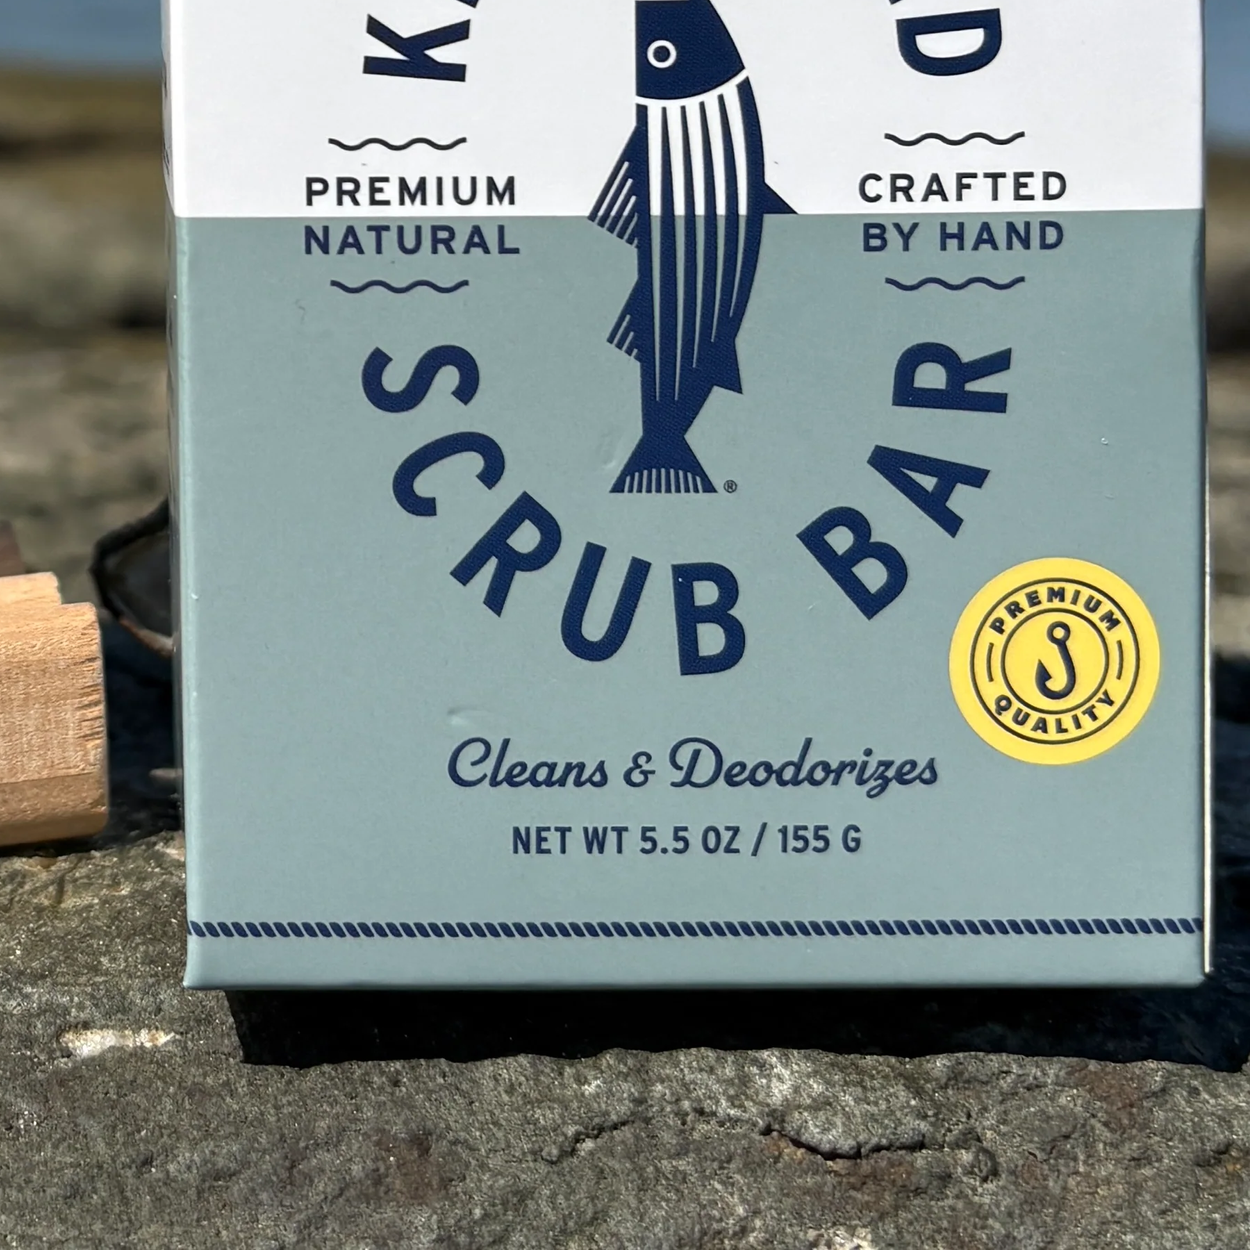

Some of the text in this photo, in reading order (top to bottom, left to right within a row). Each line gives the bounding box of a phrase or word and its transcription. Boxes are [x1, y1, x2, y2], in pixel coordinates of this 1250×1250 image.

[306, 176, 515, 206] PREMIUM
[859, 172, 1067, 202] CRAFTED
[304, 225, 520, 255] NATURAL
[863, 221, 1064, 252] BY HAND
[362, 342, 1012, 676] SCRUB BAR
[989, 586, 1121, 635] PREMIUM
[995, 689, 1115, 734] QUALITY
[447, 737, 938, 799] Cleans & Deodorizes
[512, 822, 862, 857] NET WT 5.5 OZ / 155 G
